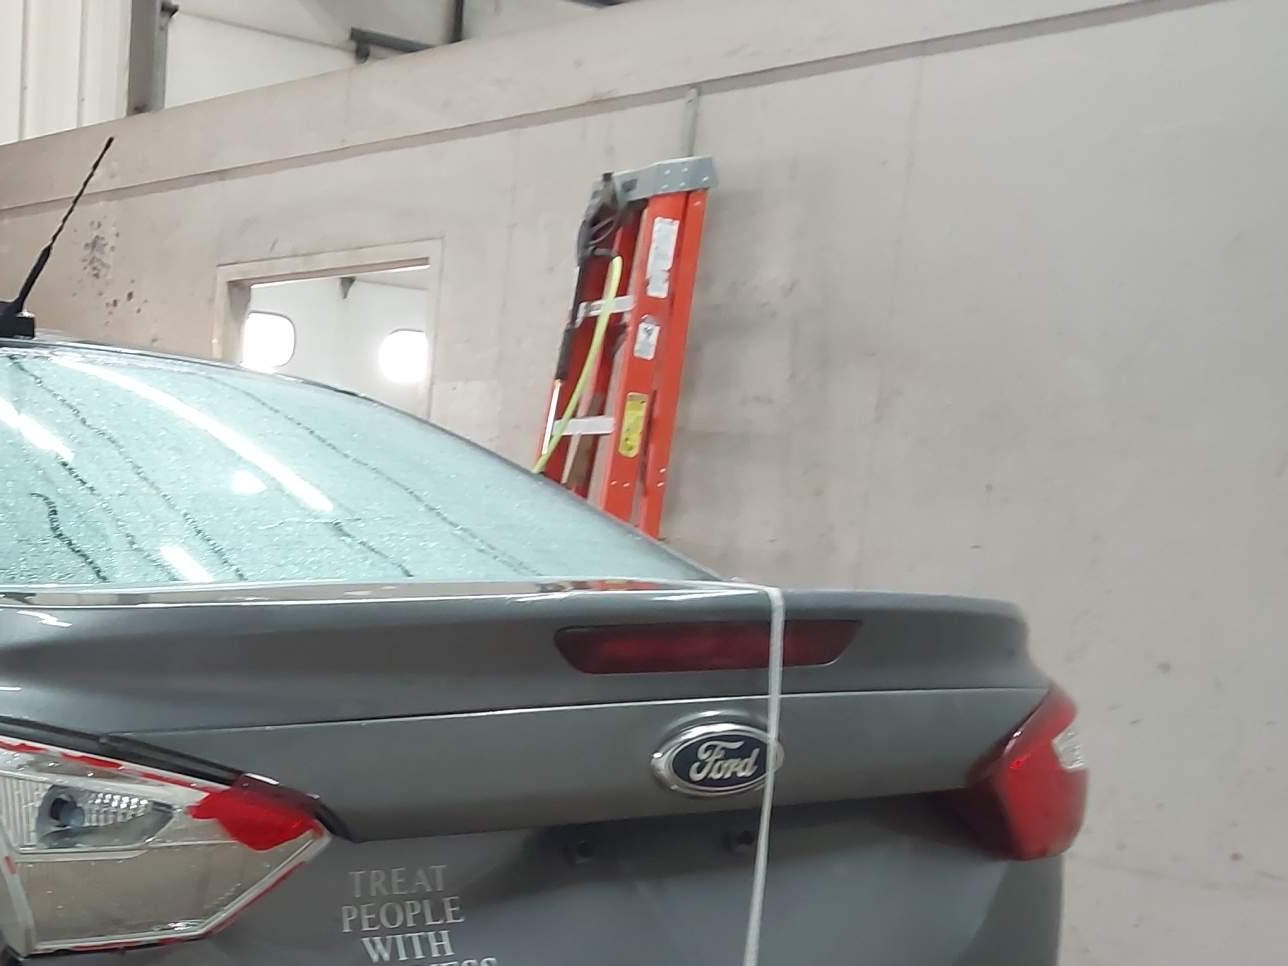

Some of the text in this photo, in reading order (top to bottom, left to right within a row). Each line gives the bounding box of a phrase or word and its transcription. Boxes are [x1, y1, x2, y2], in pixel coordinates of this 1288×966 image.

[689, 740, 760, 782] Ford
[349, 865, 447, 898] TREAT
[341, 896, 464, 933] PEOPLE
[362, 930, 455, 963] WITH
